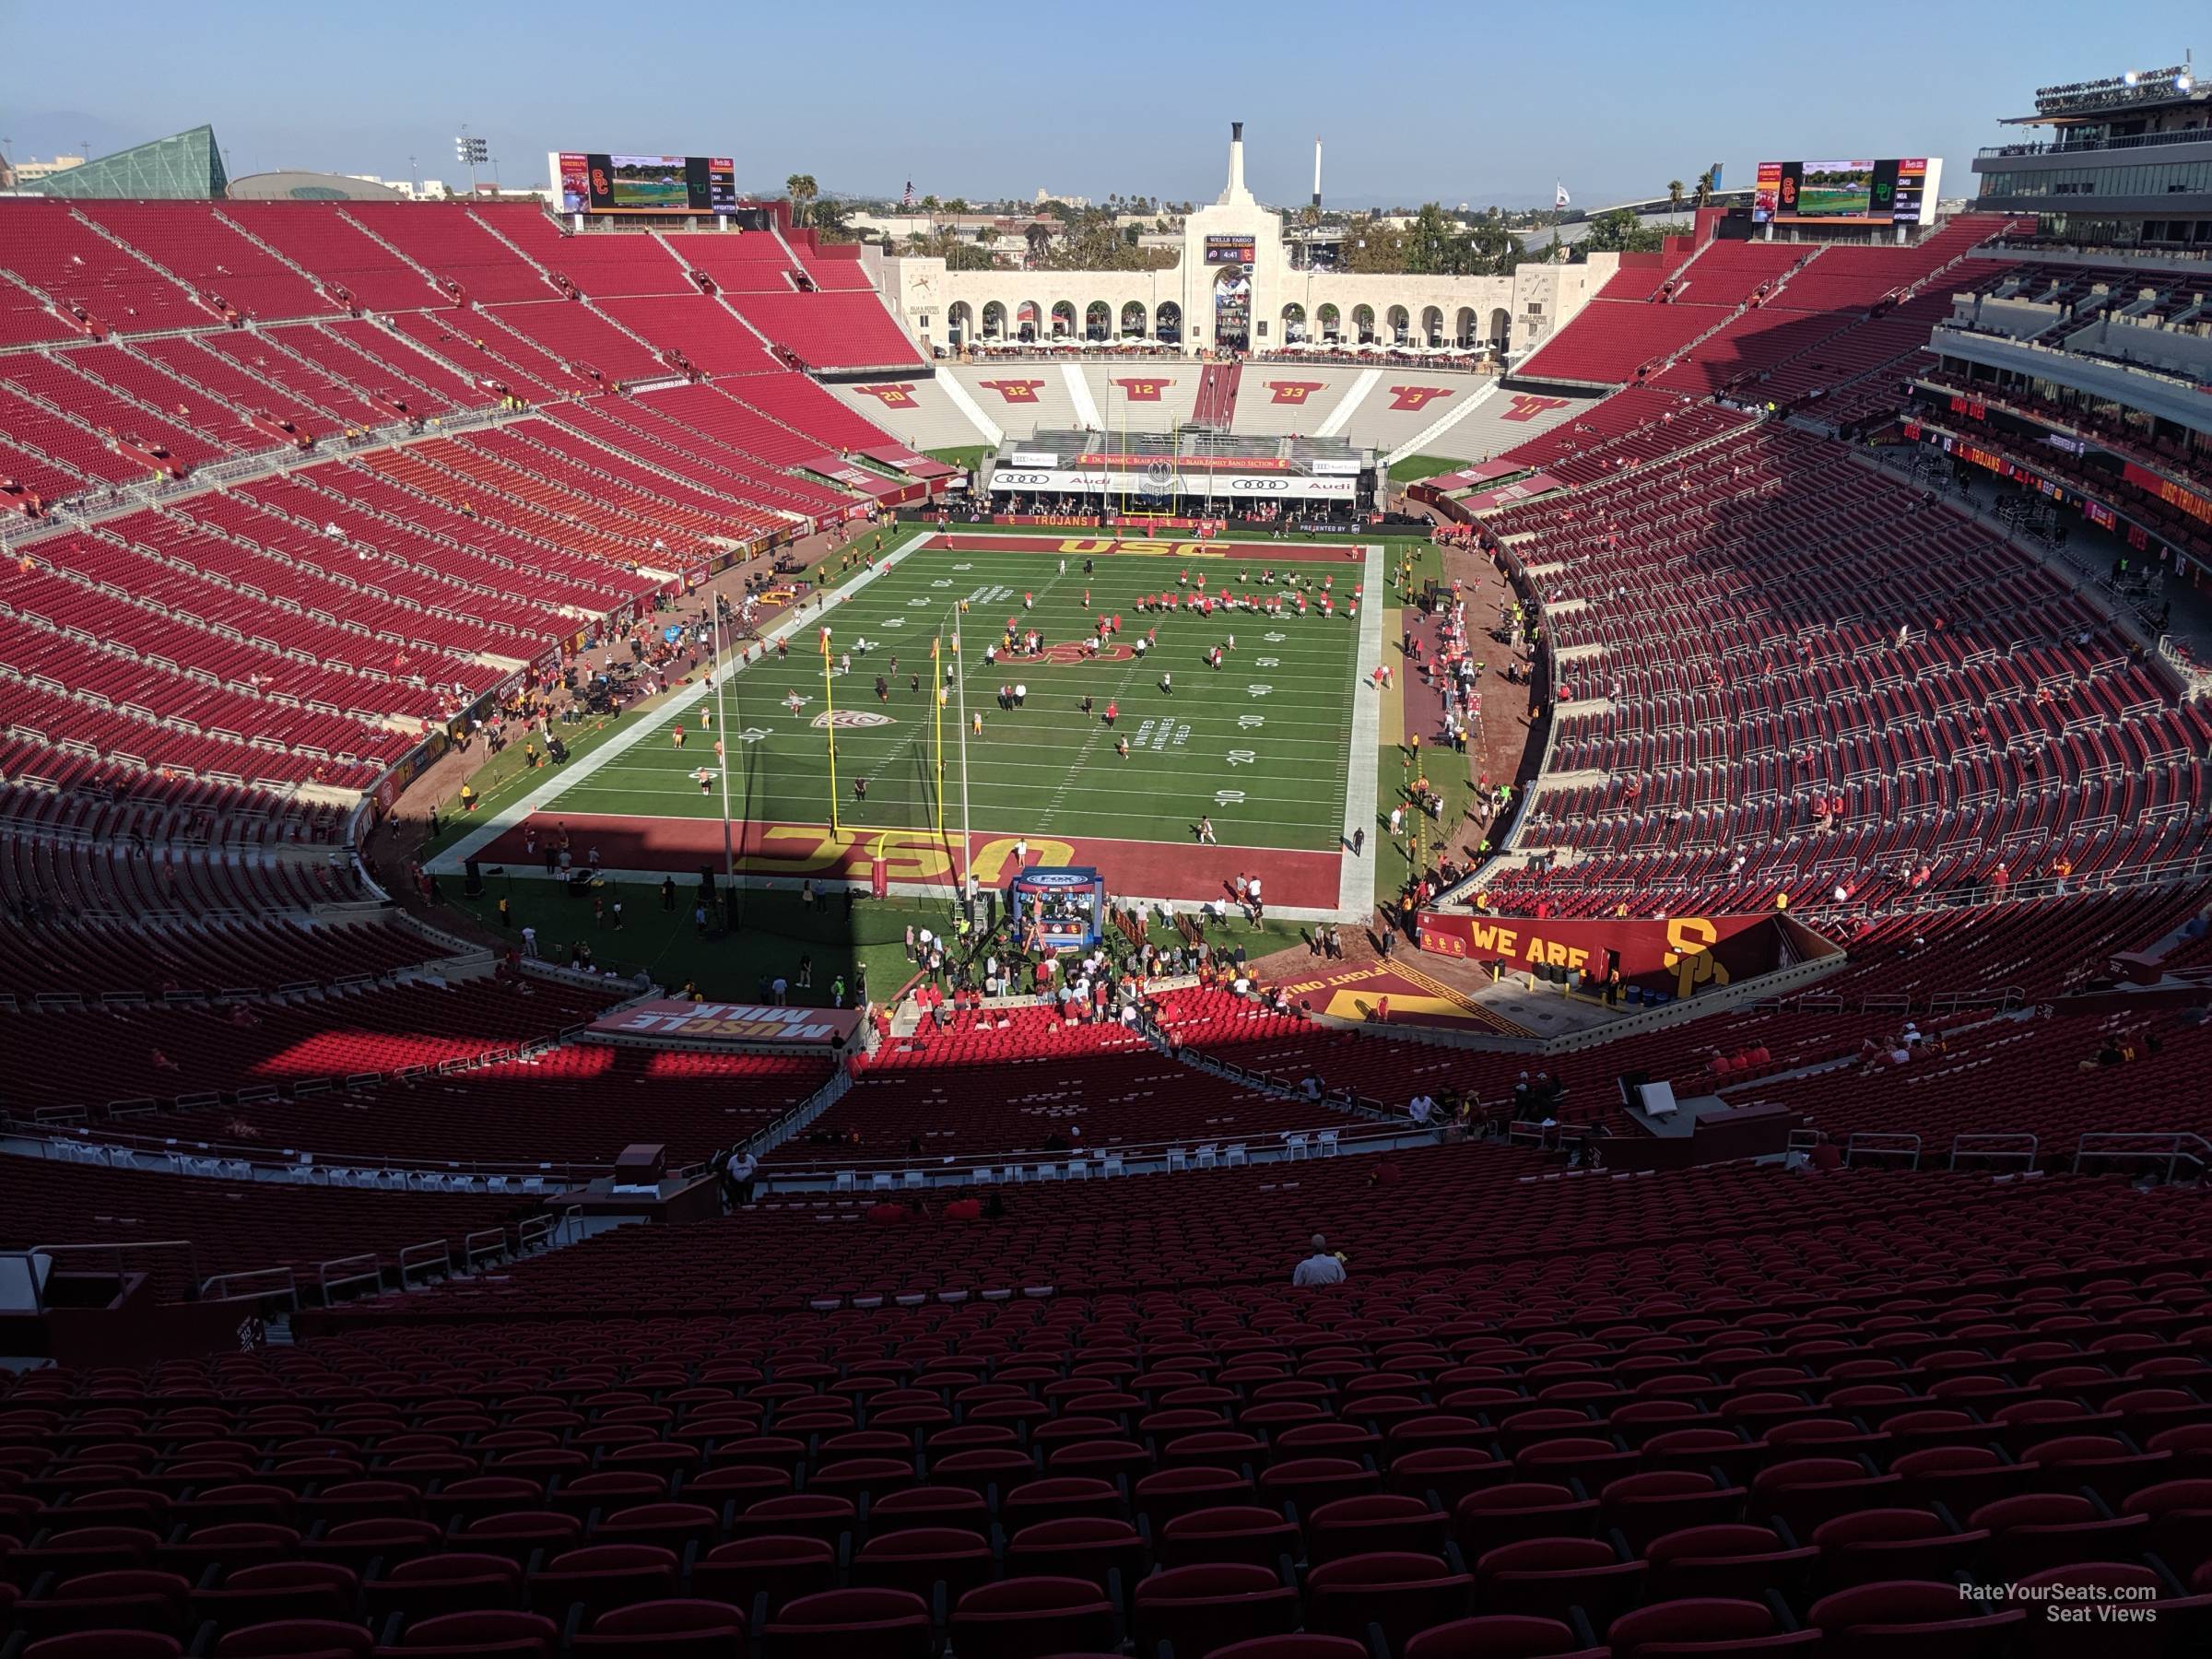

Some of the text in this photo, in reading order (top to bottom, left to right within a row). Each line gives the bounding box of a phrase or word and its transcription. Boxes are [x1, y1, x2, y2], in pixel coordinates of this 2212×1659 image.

[880, 390, 906, 401] 20
[1006, 385, 1030, 395] 32
[1135, 384, 1154, 394] 12
[1281, 387, 1305, 397] 33
[1407, 394, 1422, 404] 3
[1518, 403, 1542, 414] 11
[1950, 397, 1985, 421] UTAH UTES
[1903, 424, 1921, 441] UTES
[1944, 438, 1952, 452] VS
[1972, 448, 2001, 473] TROJANS
[2161, 479, 2177, 504] USC
[1034, 515, 1088, 526] TROJANS
[1058, 539, 1231, 558] USC
[1255, 657, 1280, 667] 50
[1247, 684, 1273, 696] 40
[1237, 714, 1265, 728] 30
[1133, 720, 1156, 747] UNITED
[1151, 717, 1176, 751] AIRLINES
[1172, 724, 1192, 746] FIELD
[1226, 749, 1256, 764] 20
[1214, 789, 1246, 804] 10
[733, 826, 1076, 883] USC
[1472, 920, 1590, 978] WE ARE
[1664, 917, 1730, 999] SC
[1326, 966, 1389, 986] FIGHT
[685, 1004, 814, 1024] MILK
[618, 1014, 834, 1038] MUSCLE
